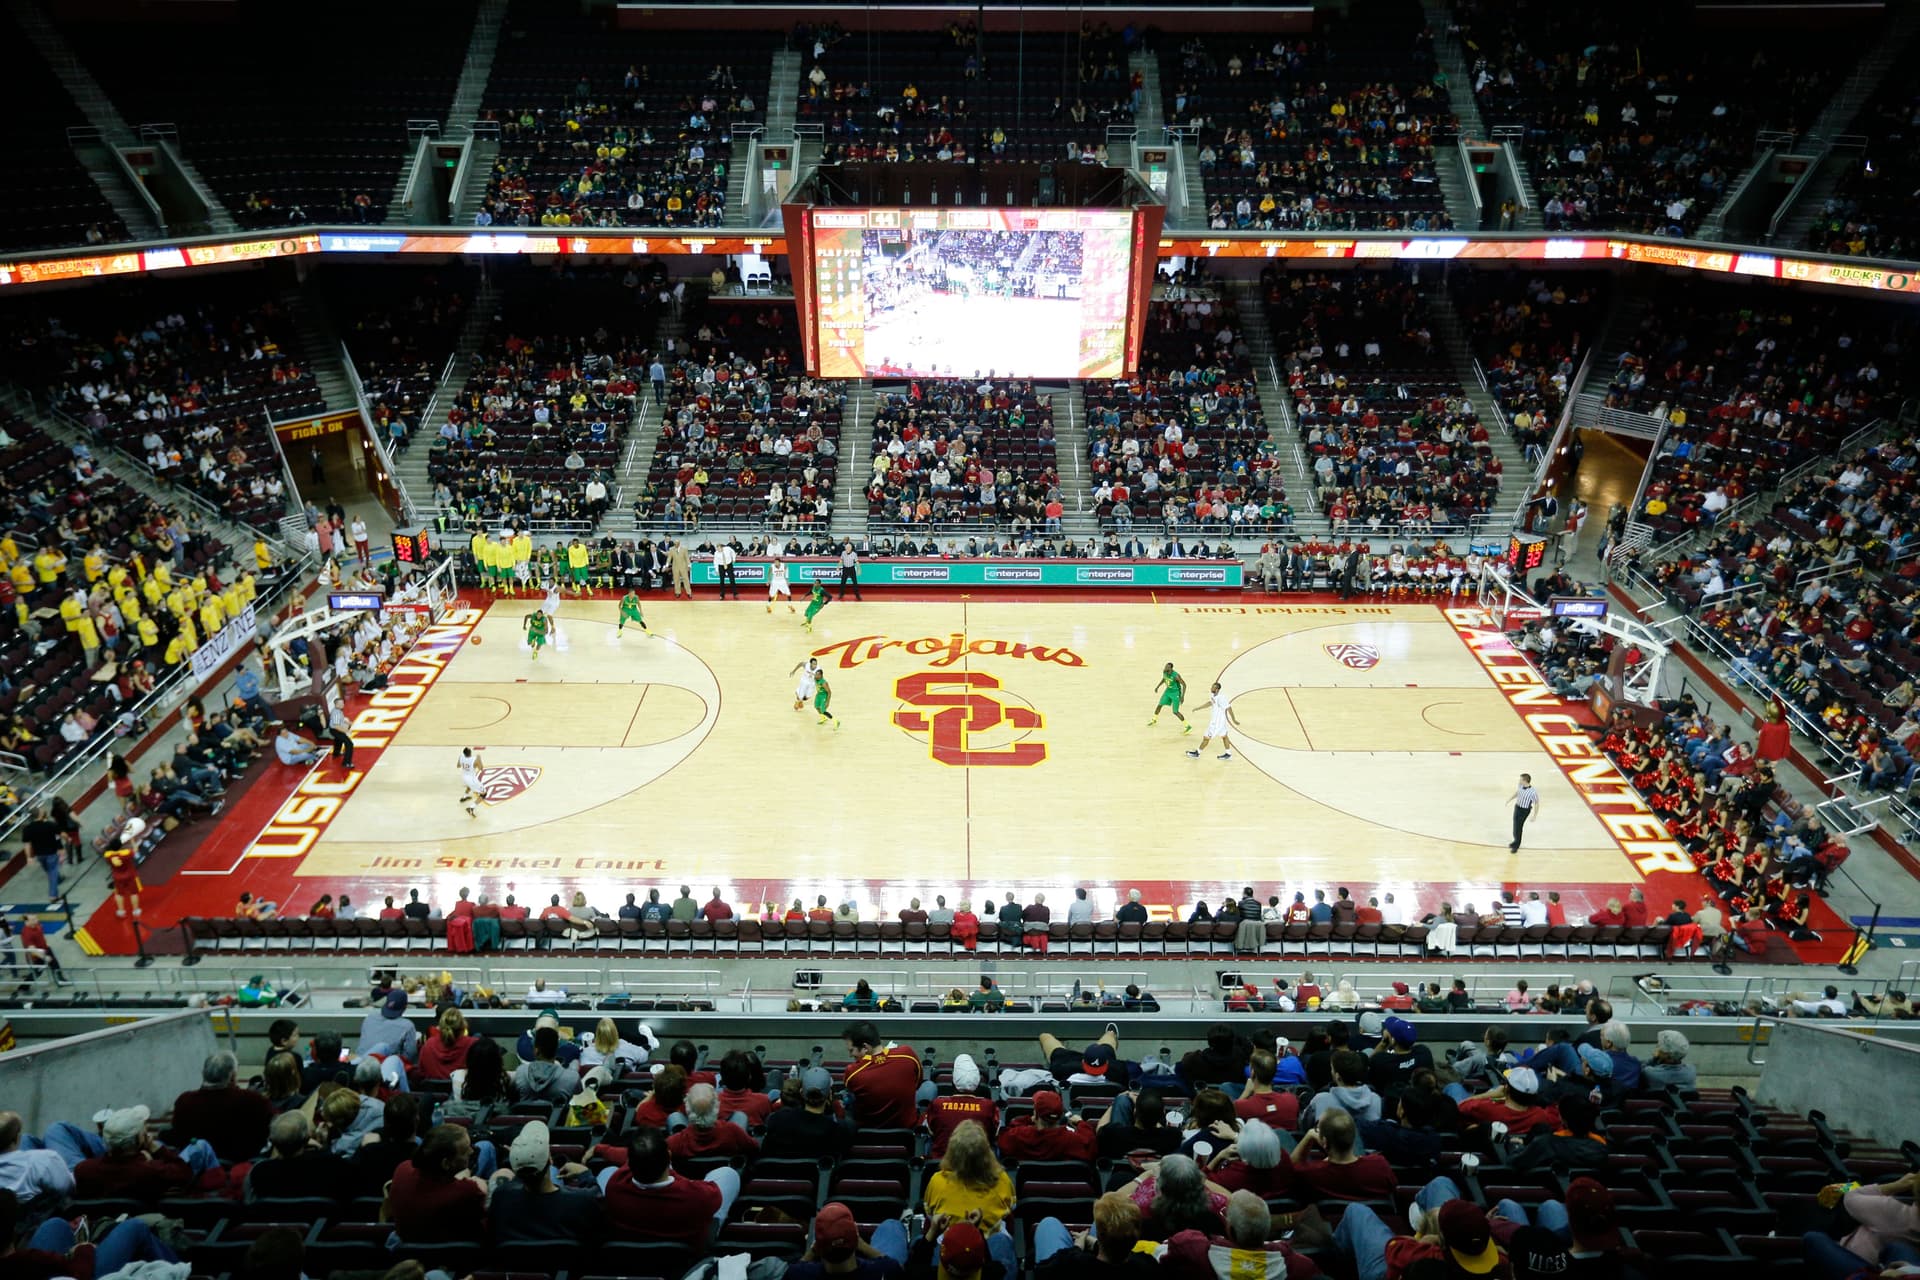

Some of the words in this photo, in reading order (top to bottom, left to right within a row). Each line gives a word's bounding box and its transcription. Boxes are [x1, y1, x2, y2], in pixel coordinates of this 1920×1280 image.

[1830, 266, 1882, 281] DUCKS
[291, 424, 324, 440] FIGHT
[328, 421, 343, 432] ON
[1525, 551, 1541, 568] 32
[894, 568, 948, 579] enterprise
[986, 569, 1040, 580] enterprise
[1079, 570, 1132, 580] enterprise
[1169, 571, 1224, 582] enterprise
[811, 633, 1089, 669] Trojans
[889, 671, 1050, 768] SC
[243, 769, 364, 859] USC
[331, 607, 484, 752] TROJANS
[1524, 712, 1698, 876] CENTER
[360, 856, 422, 868] Jim
[433, 856, 562, 869] Sterkel
[571, 857, 669, 870] Court
[1293, 909, 1307, 921] 32
[942, 1102, 981, 1112] TROJANS
